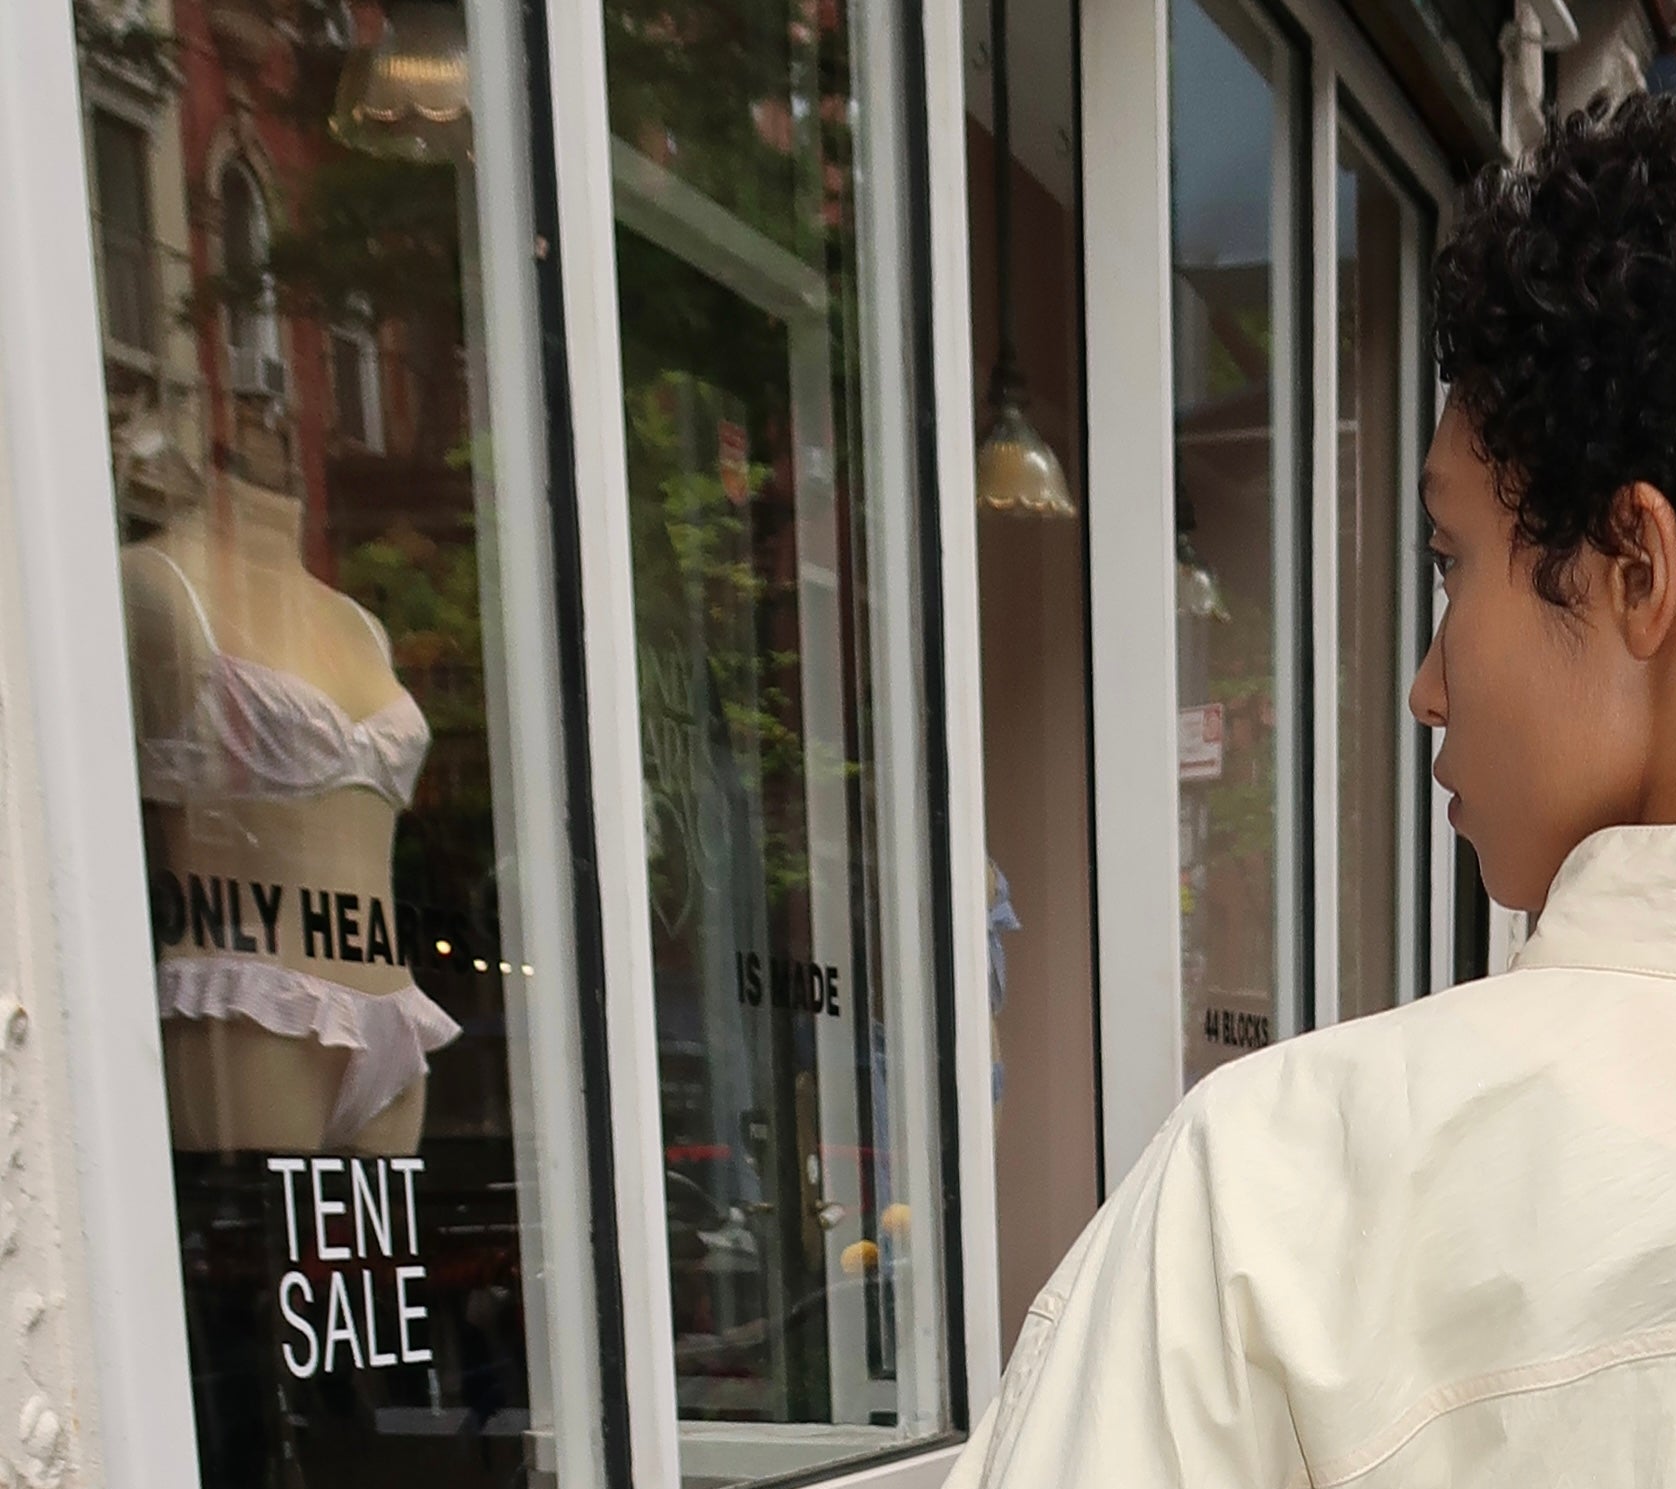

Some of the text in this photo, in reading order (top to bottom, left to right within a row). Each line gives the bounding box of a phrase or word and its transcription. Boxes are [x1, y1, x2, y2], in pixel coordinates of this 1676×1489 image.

[153, 869, 282, 953] ONLY
[736, 951, 762, 1006] IS
[1223, 1010, 1269, 1047] BLOCKS
[267, 1157, 426, 1262] TENT
[279, 1267, 433, 1379] SALE
